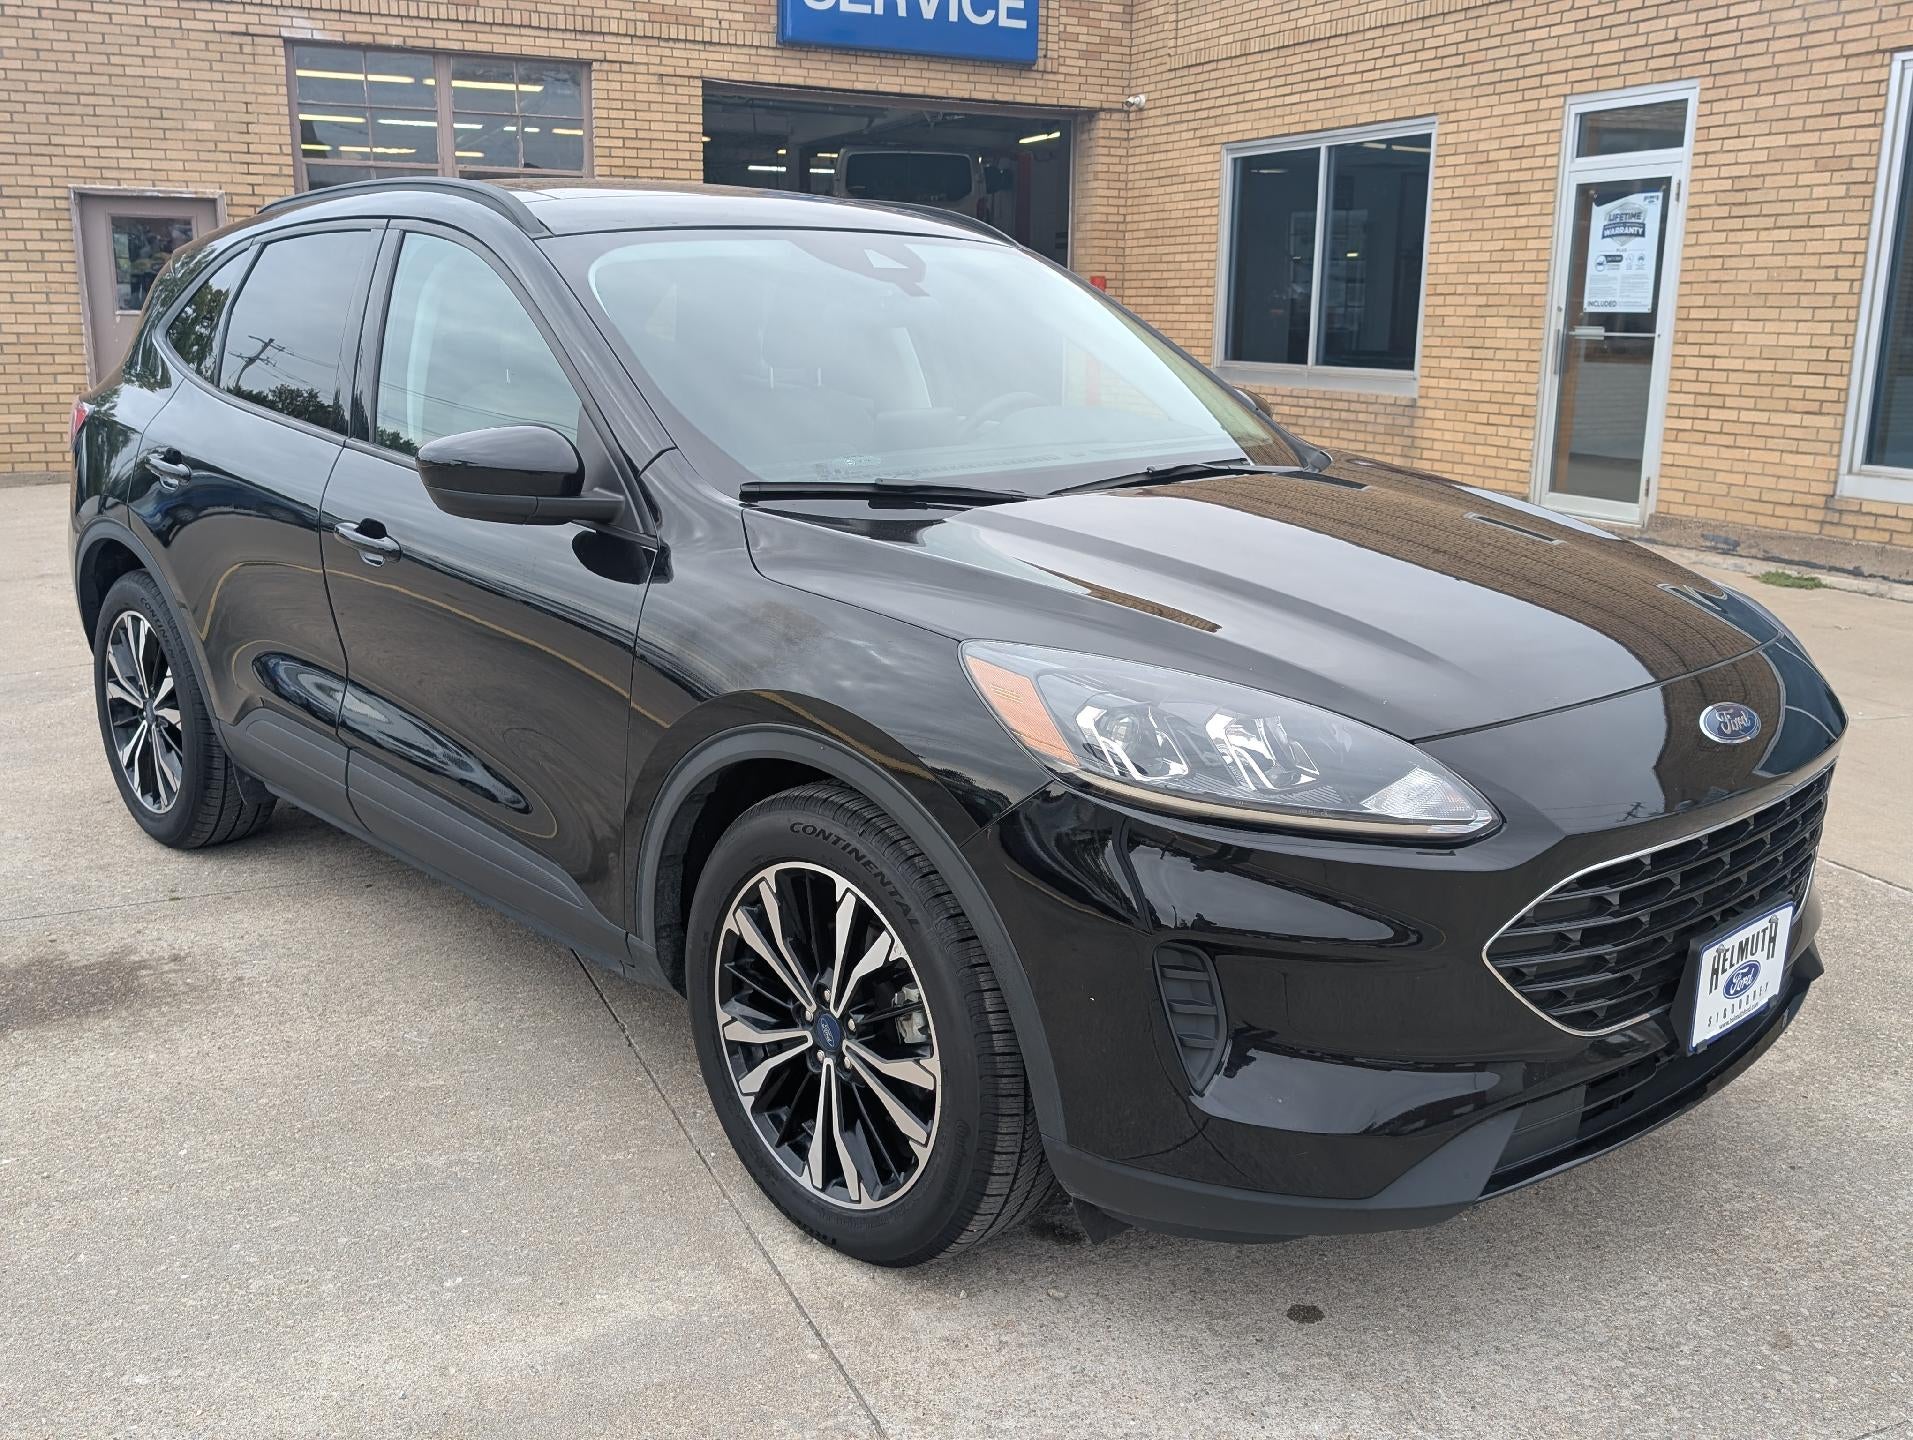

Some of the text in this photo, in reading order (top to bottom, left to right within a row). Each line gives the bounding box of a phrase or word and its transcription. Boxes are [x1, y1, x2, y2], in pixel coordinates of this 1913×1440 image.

[803, 0, 1028, 29] VICE
[1608, 211, 1643, 222] LIFETIME
[1603, 226, 1644, 236] WARRANTY
[1587, 300, 1618, 308] INCLUDED
[789, 822, 920, 932] CONTINENTAL
[1708, 919, 1779, 996] HELMUTH
